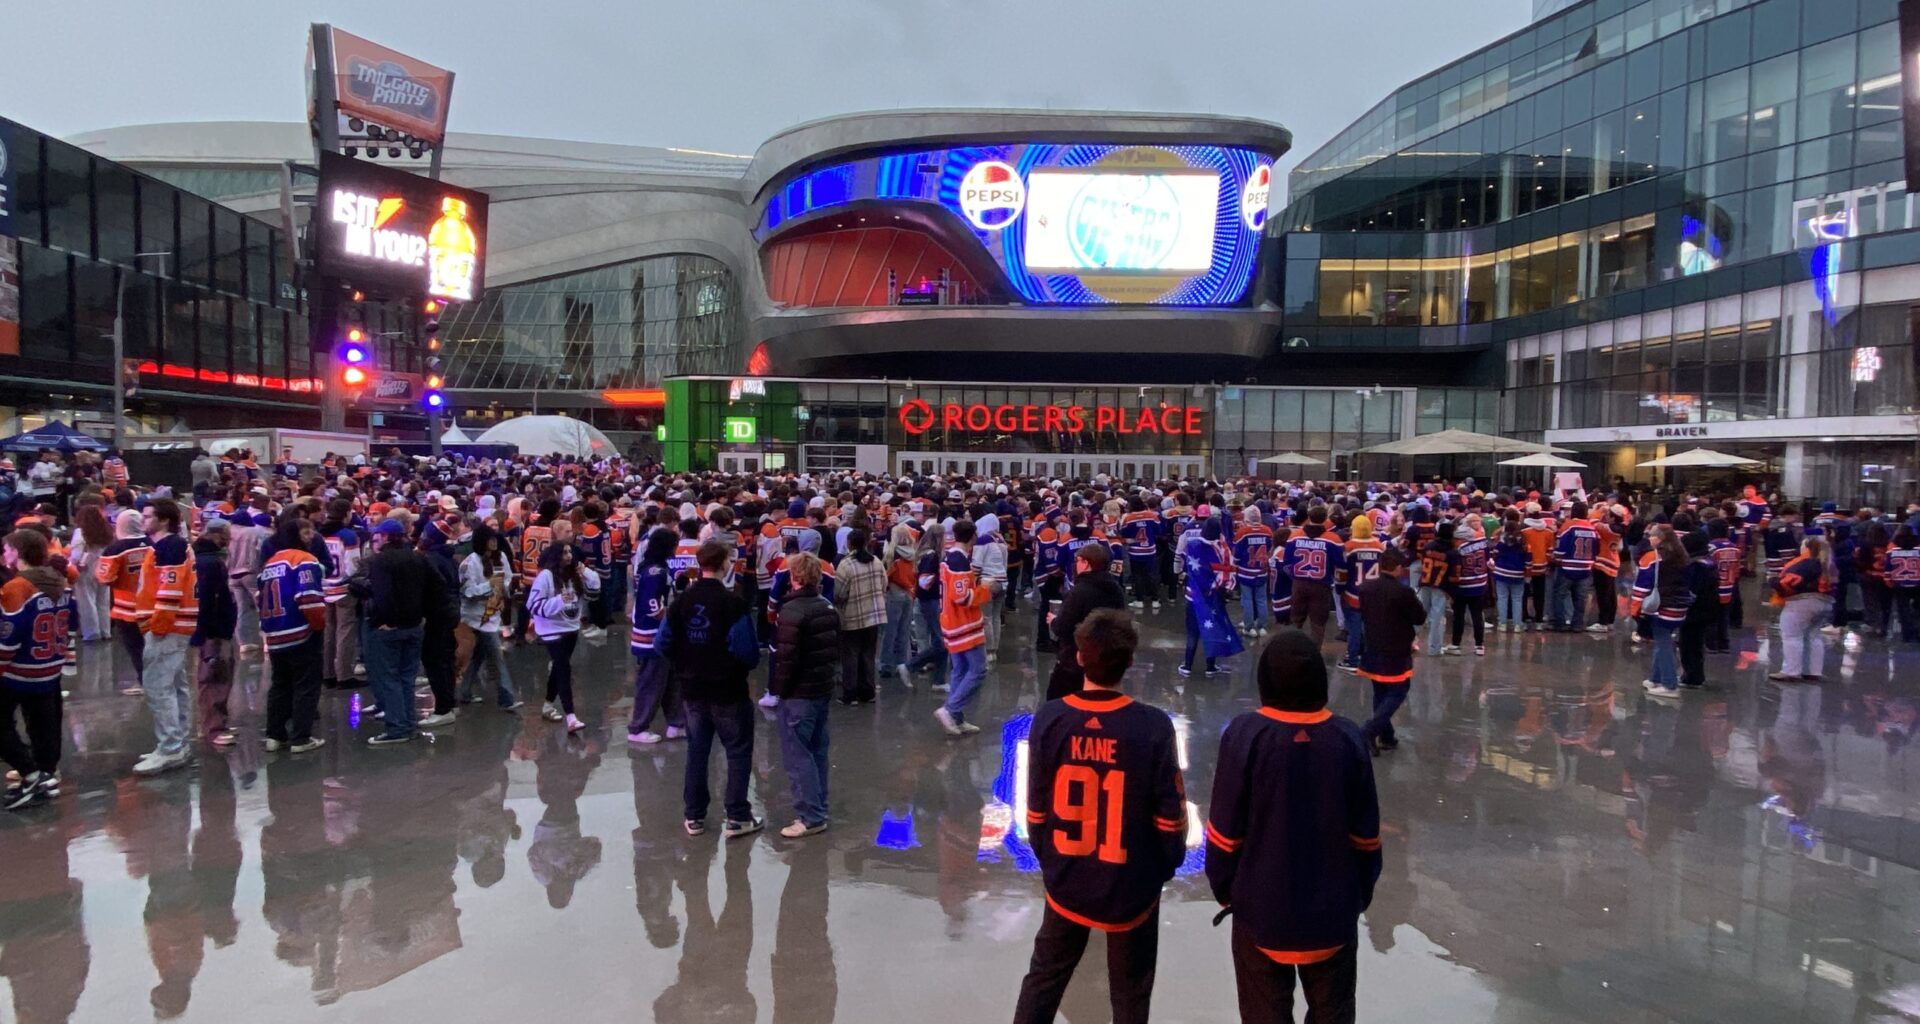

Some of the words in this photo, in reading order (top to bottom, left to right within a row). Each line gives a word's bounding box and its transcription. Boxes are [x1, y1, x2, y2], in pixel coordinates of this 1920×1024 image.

[356, 63, 430, 97] TAILGATE
[371, 86, 429, 106] PARTY
[966, 189, 1019, 203] PEPSI
[373, 230, 427, 266] YOU?
[729, 421, 752, 437] TD
[943, 403, 1084, 432] ROGERS
[1097, 406, 1202, 434] PLACE
[1656, 427, 1708, 438] BRAVEN
[1294, 549, 1326, 579] 29
[1355, 562, 1380, 586] 14
[1421, 558, 1448, 587] 97
[1071, 736, 1117, 764] KANE
[1053, 764, 1128, 865] 91
